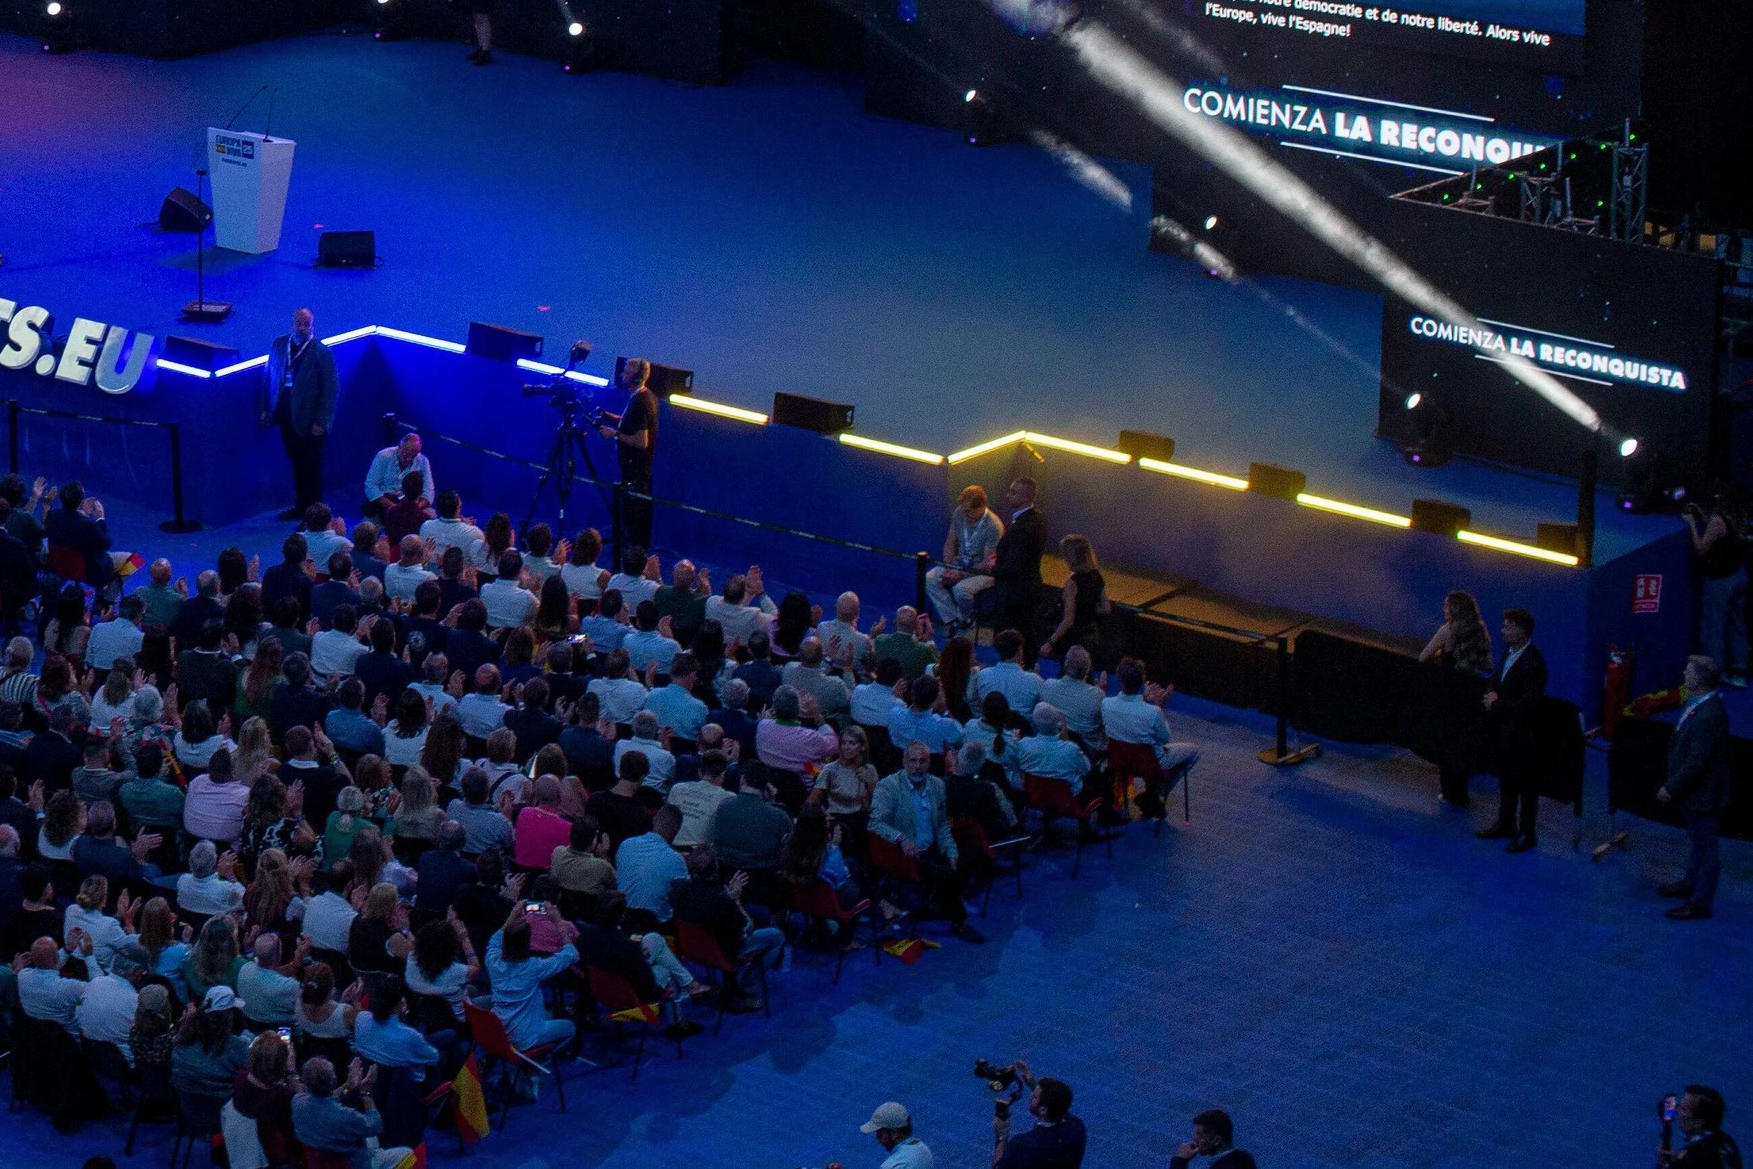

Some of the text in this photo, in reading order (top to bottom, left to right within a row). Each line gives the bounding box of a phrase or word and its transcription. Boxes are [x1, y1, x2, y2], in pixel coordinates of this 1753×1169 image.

[1205, 2, 1352, 37] l'Europe, vive l'Espagne!
[1365, 8, 1379, 21] et
[1381, 9, 1398, 23] de
[1400, 13, 1435, 29] notre
[1438, 16, 1482, 36] liberté.
[1485, 24, 1520, 42] Alors
[1523, 30, 1550, 46] vive
[1183, 88, 1327, 135] COMIENZA
[1335, 112, 1373, 143] LA
[1410, 317, 1686, 390] COMIENZA LA RECONQUISTA
